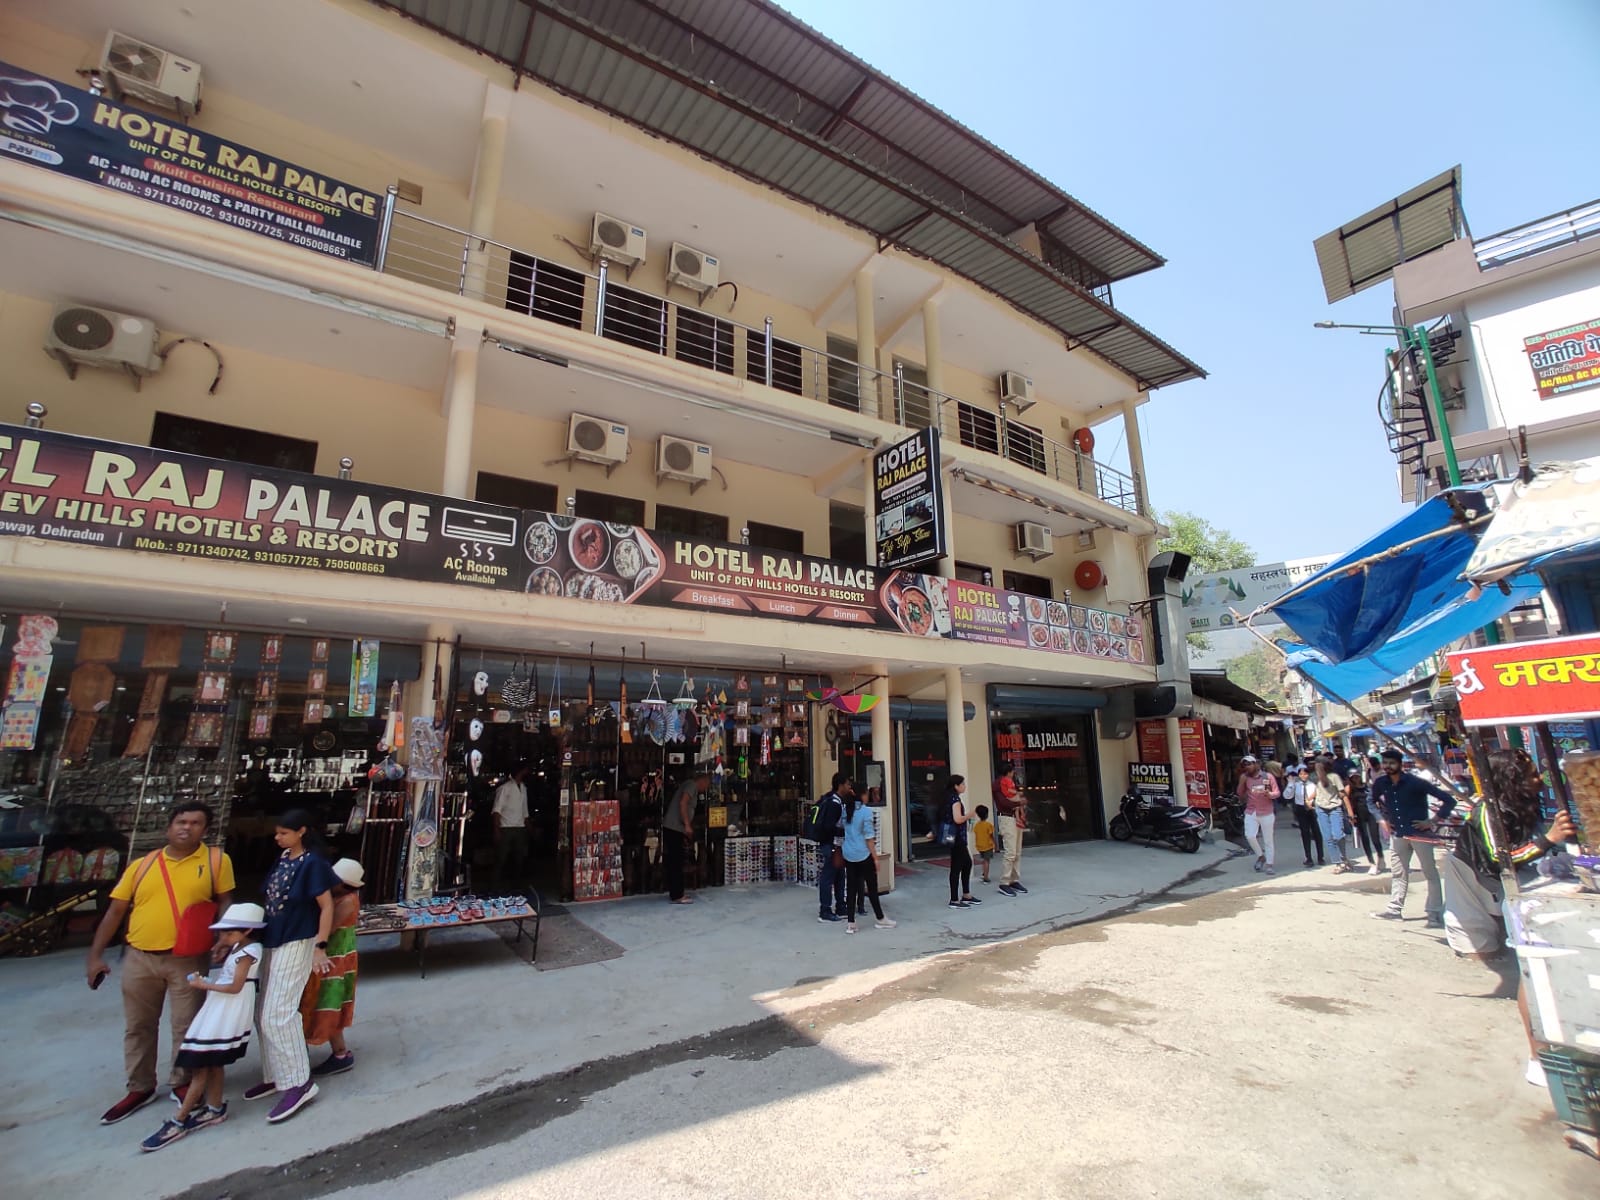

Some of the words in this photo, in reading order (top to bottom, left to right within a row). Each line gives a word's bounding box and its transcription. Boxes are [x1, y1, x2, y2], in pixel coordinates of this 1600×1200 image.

[94, 102, 206, 159] HOTEL
[217, 144, 277, 181] RAJ
[284, 168, 376, 215] PALACE
[129, 140, 158, 154] UNIT
[161, 150, 179, 161] OF
[181, 157, 205, 170] DEV
[208, 165, 238, 182] HILLS
[242, 177, 283, 197] HOTELS
[287, 192, 294, 200] &
[298, 196, 341, 217] RESORTS
[153, 161, 188, 179] Multi
[192, 173, 243, 196] Cuisine
[247, 191, 317, 222] Restaurant
[89, 155, 110, 169] AC
[121, 165, 149, 181] NON
[151, 174, 170, 188] AC
[173, 182, 220, 204] ROOMS
[222, 198, 232, 209] &
[235, 200, 276, 221] PARTY
[276, 214, 303, 232] HALL
[305, 224, 362, 249] AVAILABLE
[144, 188, 215, 217] 9711340742,
[219, 211, 285, 239] 9310577725,
[289, 232, 346, 257] 7505008663
[877, 473, 892, 490] RAJ
[894, 455, 927, 482] PALACE
[878, 435, 926, 476] HOTEL
[84, 450, 224, 510] RAJ
[245, 479, 430, 542] PALACE
[41, 523, 105, 542] Dehradun
[55, 499, 146, 528] HILLS
[155, 511, 262, 542] HOTELS
[270, 526, 288, 545] &
[296, 529, 399, 559] RESORTS
[135, 537, 173, 550] Mob.:
[176, 542, 250, 560] 9711340742,
[255, 551, 322, 568] 9310577725,
[325, 559, 385, 573] 7505008663
[444, 557, 463, 570] AC
[466, 559, 508, 576] Rooms
[675, 541, 754, 575] HOTEL
[762, 555, 802, 581] RAJ
[810, 562, 875, 591] PALACE
[455, 572, 496, 585] Available
[690, 569, 714, 582] UNIT
[718, 574, 732, 585] OF
[735, 576, 753, 588] DEV
[756, 579, 782, 591] HILLS
[784, 583, 818, 597] HOTELS
[820, 588, 827, 597] &
[829, 589, 865, 602] RESORTS
[692, 592, 735, 607] Breakfast
[769, 601, 796, 613] Lunch
[834, 609, 859, 620] Dinner
[954, 605, 973, 621] RAJ
[975, 607, 1007, 625] PALACE
[957, 586, 1000, 609] HOTEL
[1027, 733, 1045, 751] RAJ
[1045, 733, 1078, 747] PALACE
[1131, 764, 1168, 776] HOTEL
[1145, 776, 1170, 784] PALACE
